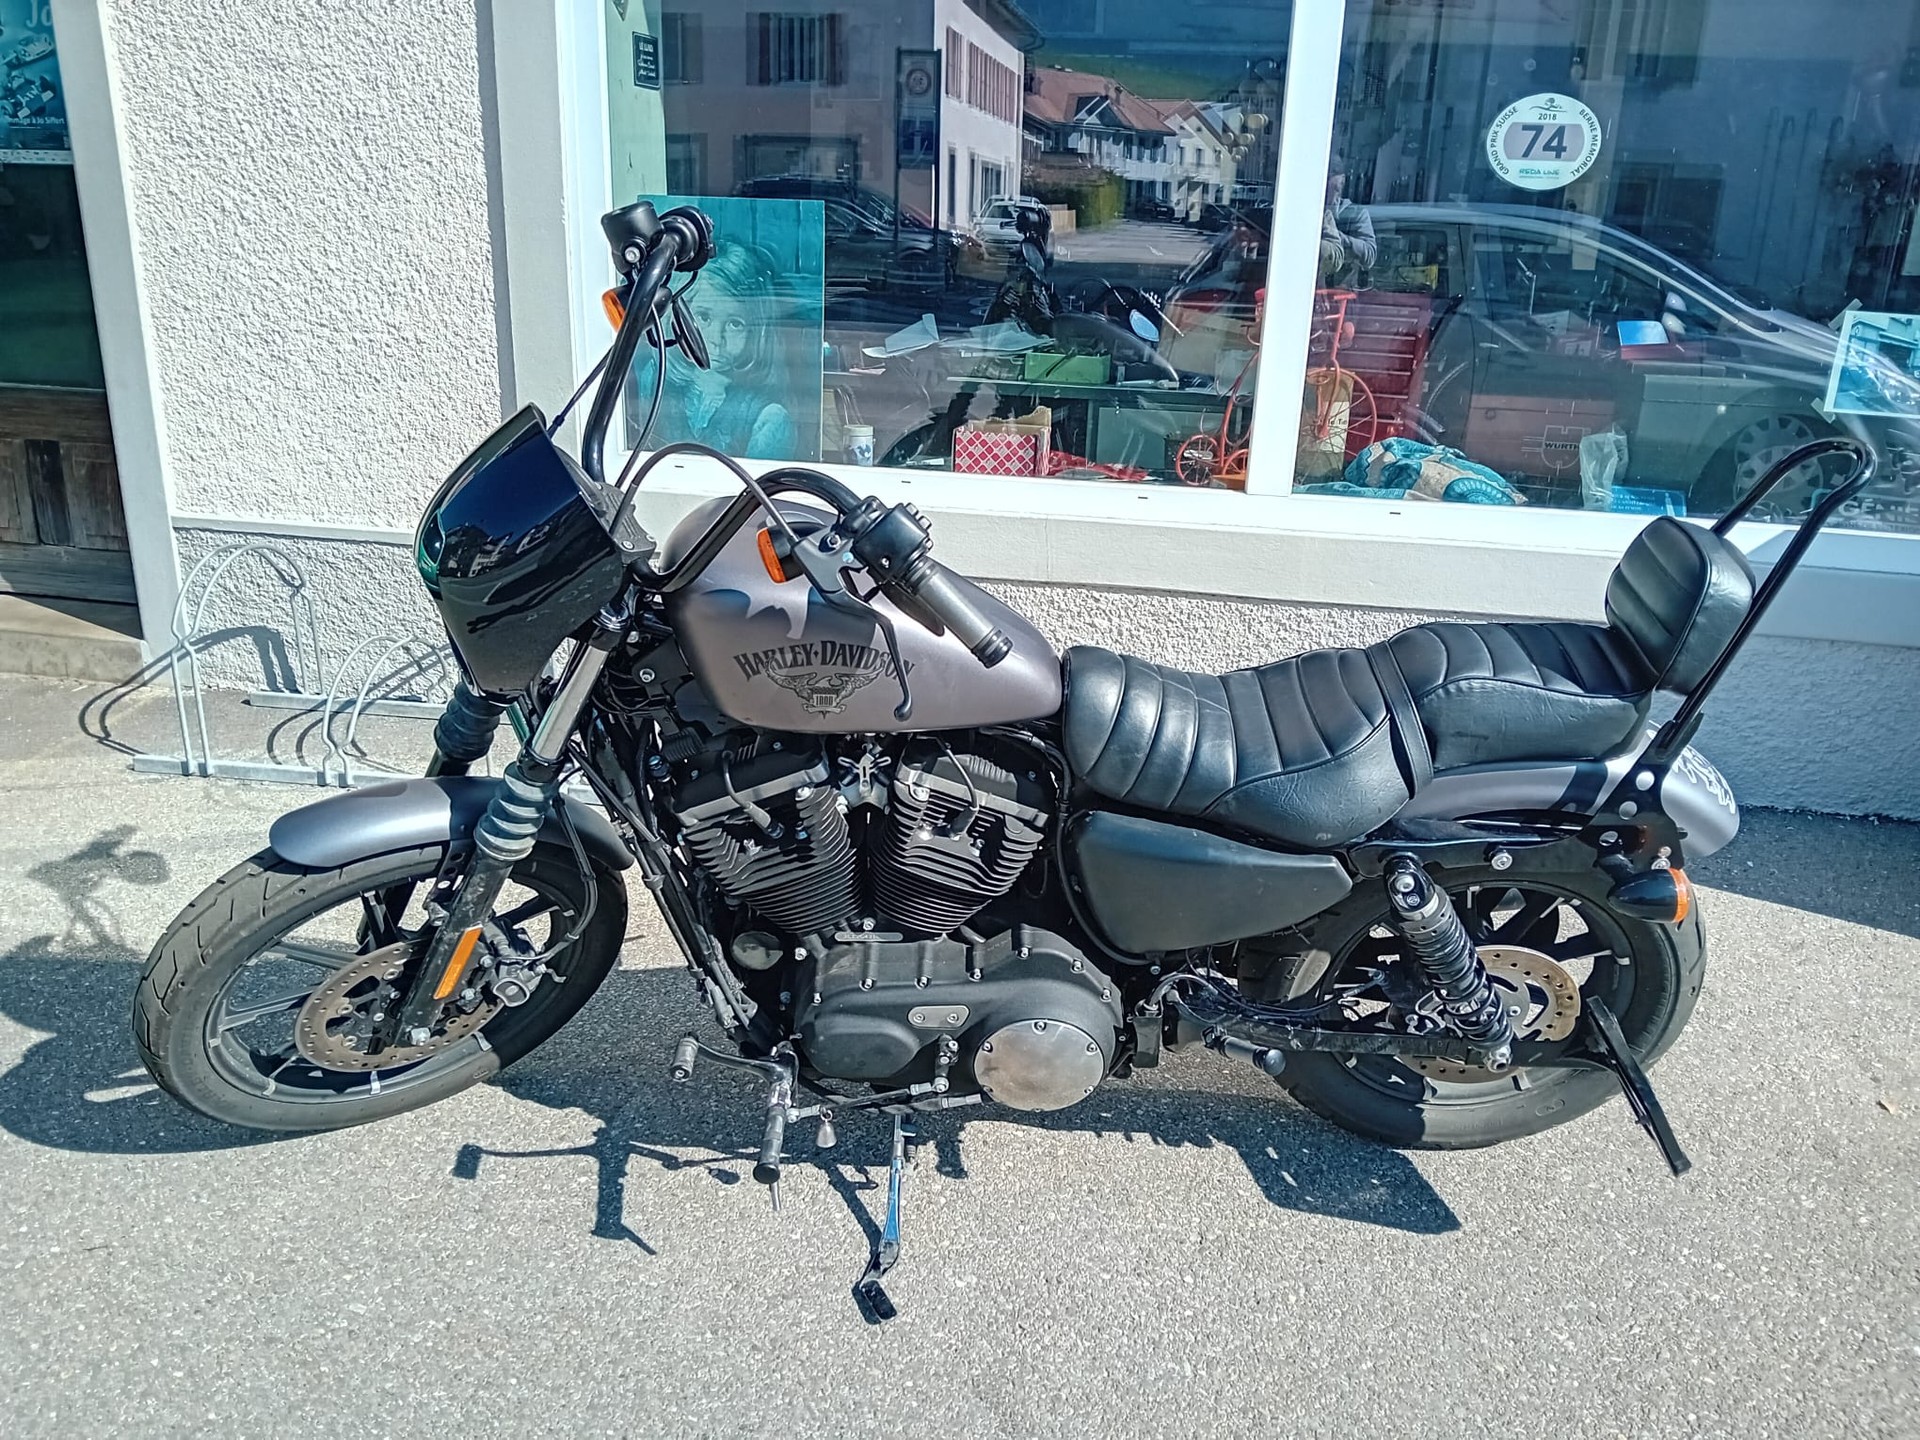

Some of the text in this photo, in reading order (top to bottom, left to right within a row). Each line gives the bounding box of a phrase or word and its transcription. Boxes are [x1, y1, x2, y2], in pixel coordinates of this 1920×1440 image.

[1490, 106, 1519, 175] GRAND PRIX SUISSE
[1521, 124, 1568, 160] 74
[1538, 113, 1557, 121] 2018
[1570, 108, 1598, 177] BERNE MEMORIAL
